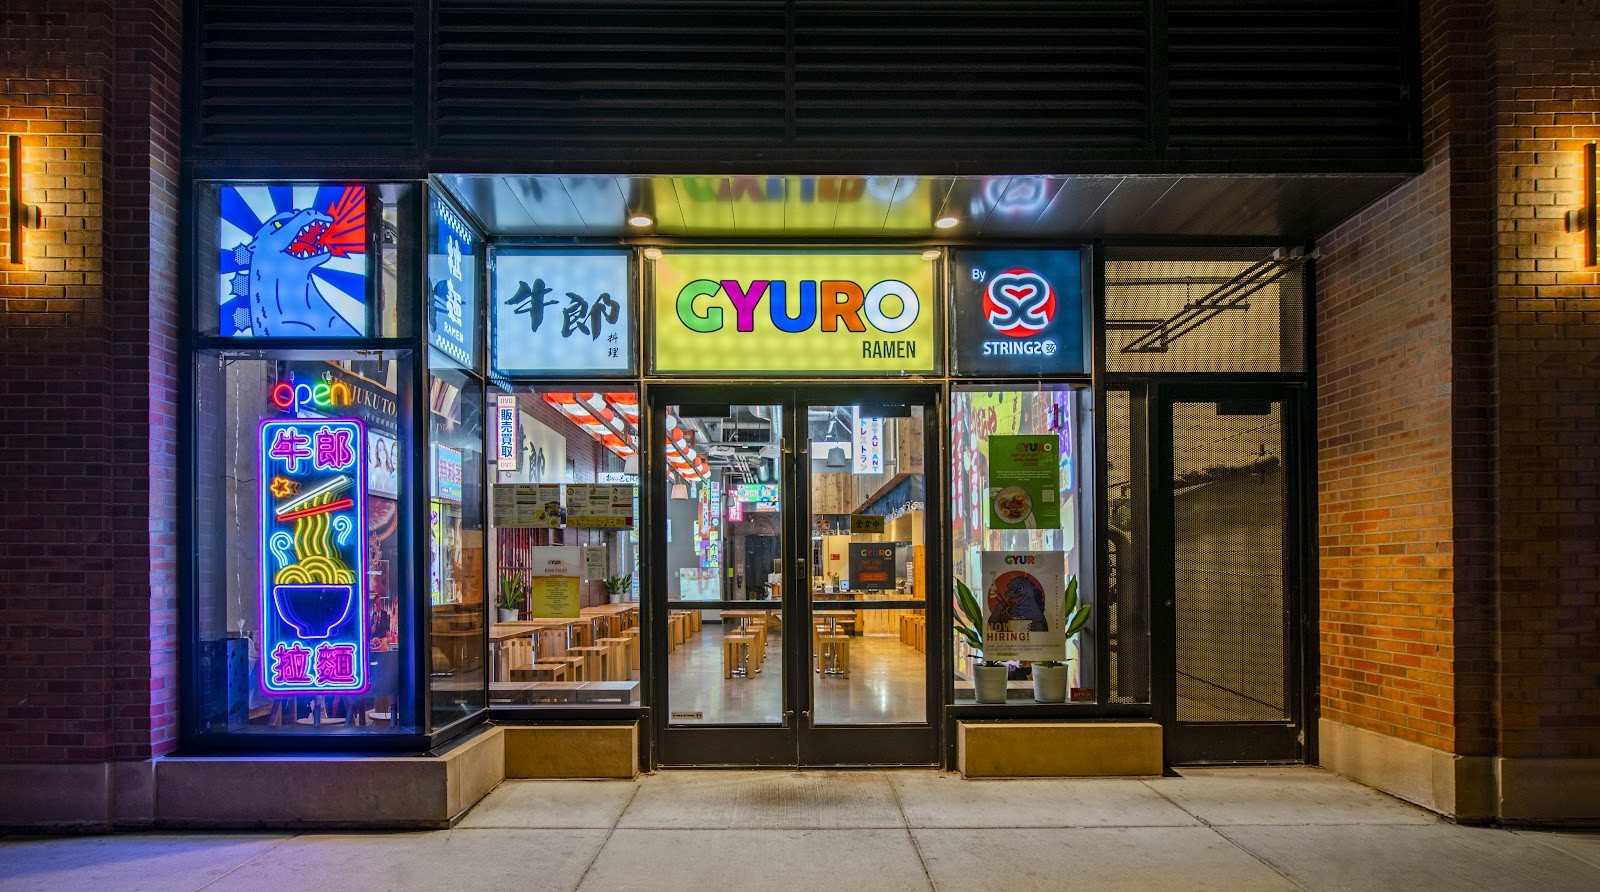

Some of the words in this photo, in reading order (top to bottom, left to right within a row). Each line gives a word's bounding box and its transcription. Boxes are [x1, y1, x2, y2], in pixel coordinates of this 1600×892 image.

[972, 268, 986, 282] By
[504, 278, 621, 342] 牛郎
[676, 279, 920, 334] GYURO
[443, 321, 464, 343] RAMEN
[607, 332, 619, 358] 料理
[862, 340, 917, 359] RAMEN
[273, 383, 349, 412] open
[381, 397, 397, 418] TO
[501, 409, 513, 458] 販売買取
[270, 427, 354, 472] 牛郎
[1016, 443, 1052, 452] GYURO
[860, 549, 892, 557] GYURO
[1004, 555, 1044, 565] GYURO
[986, 622, 1013, 632] NOW
[986, 632, 1030, 641] HIRING!
